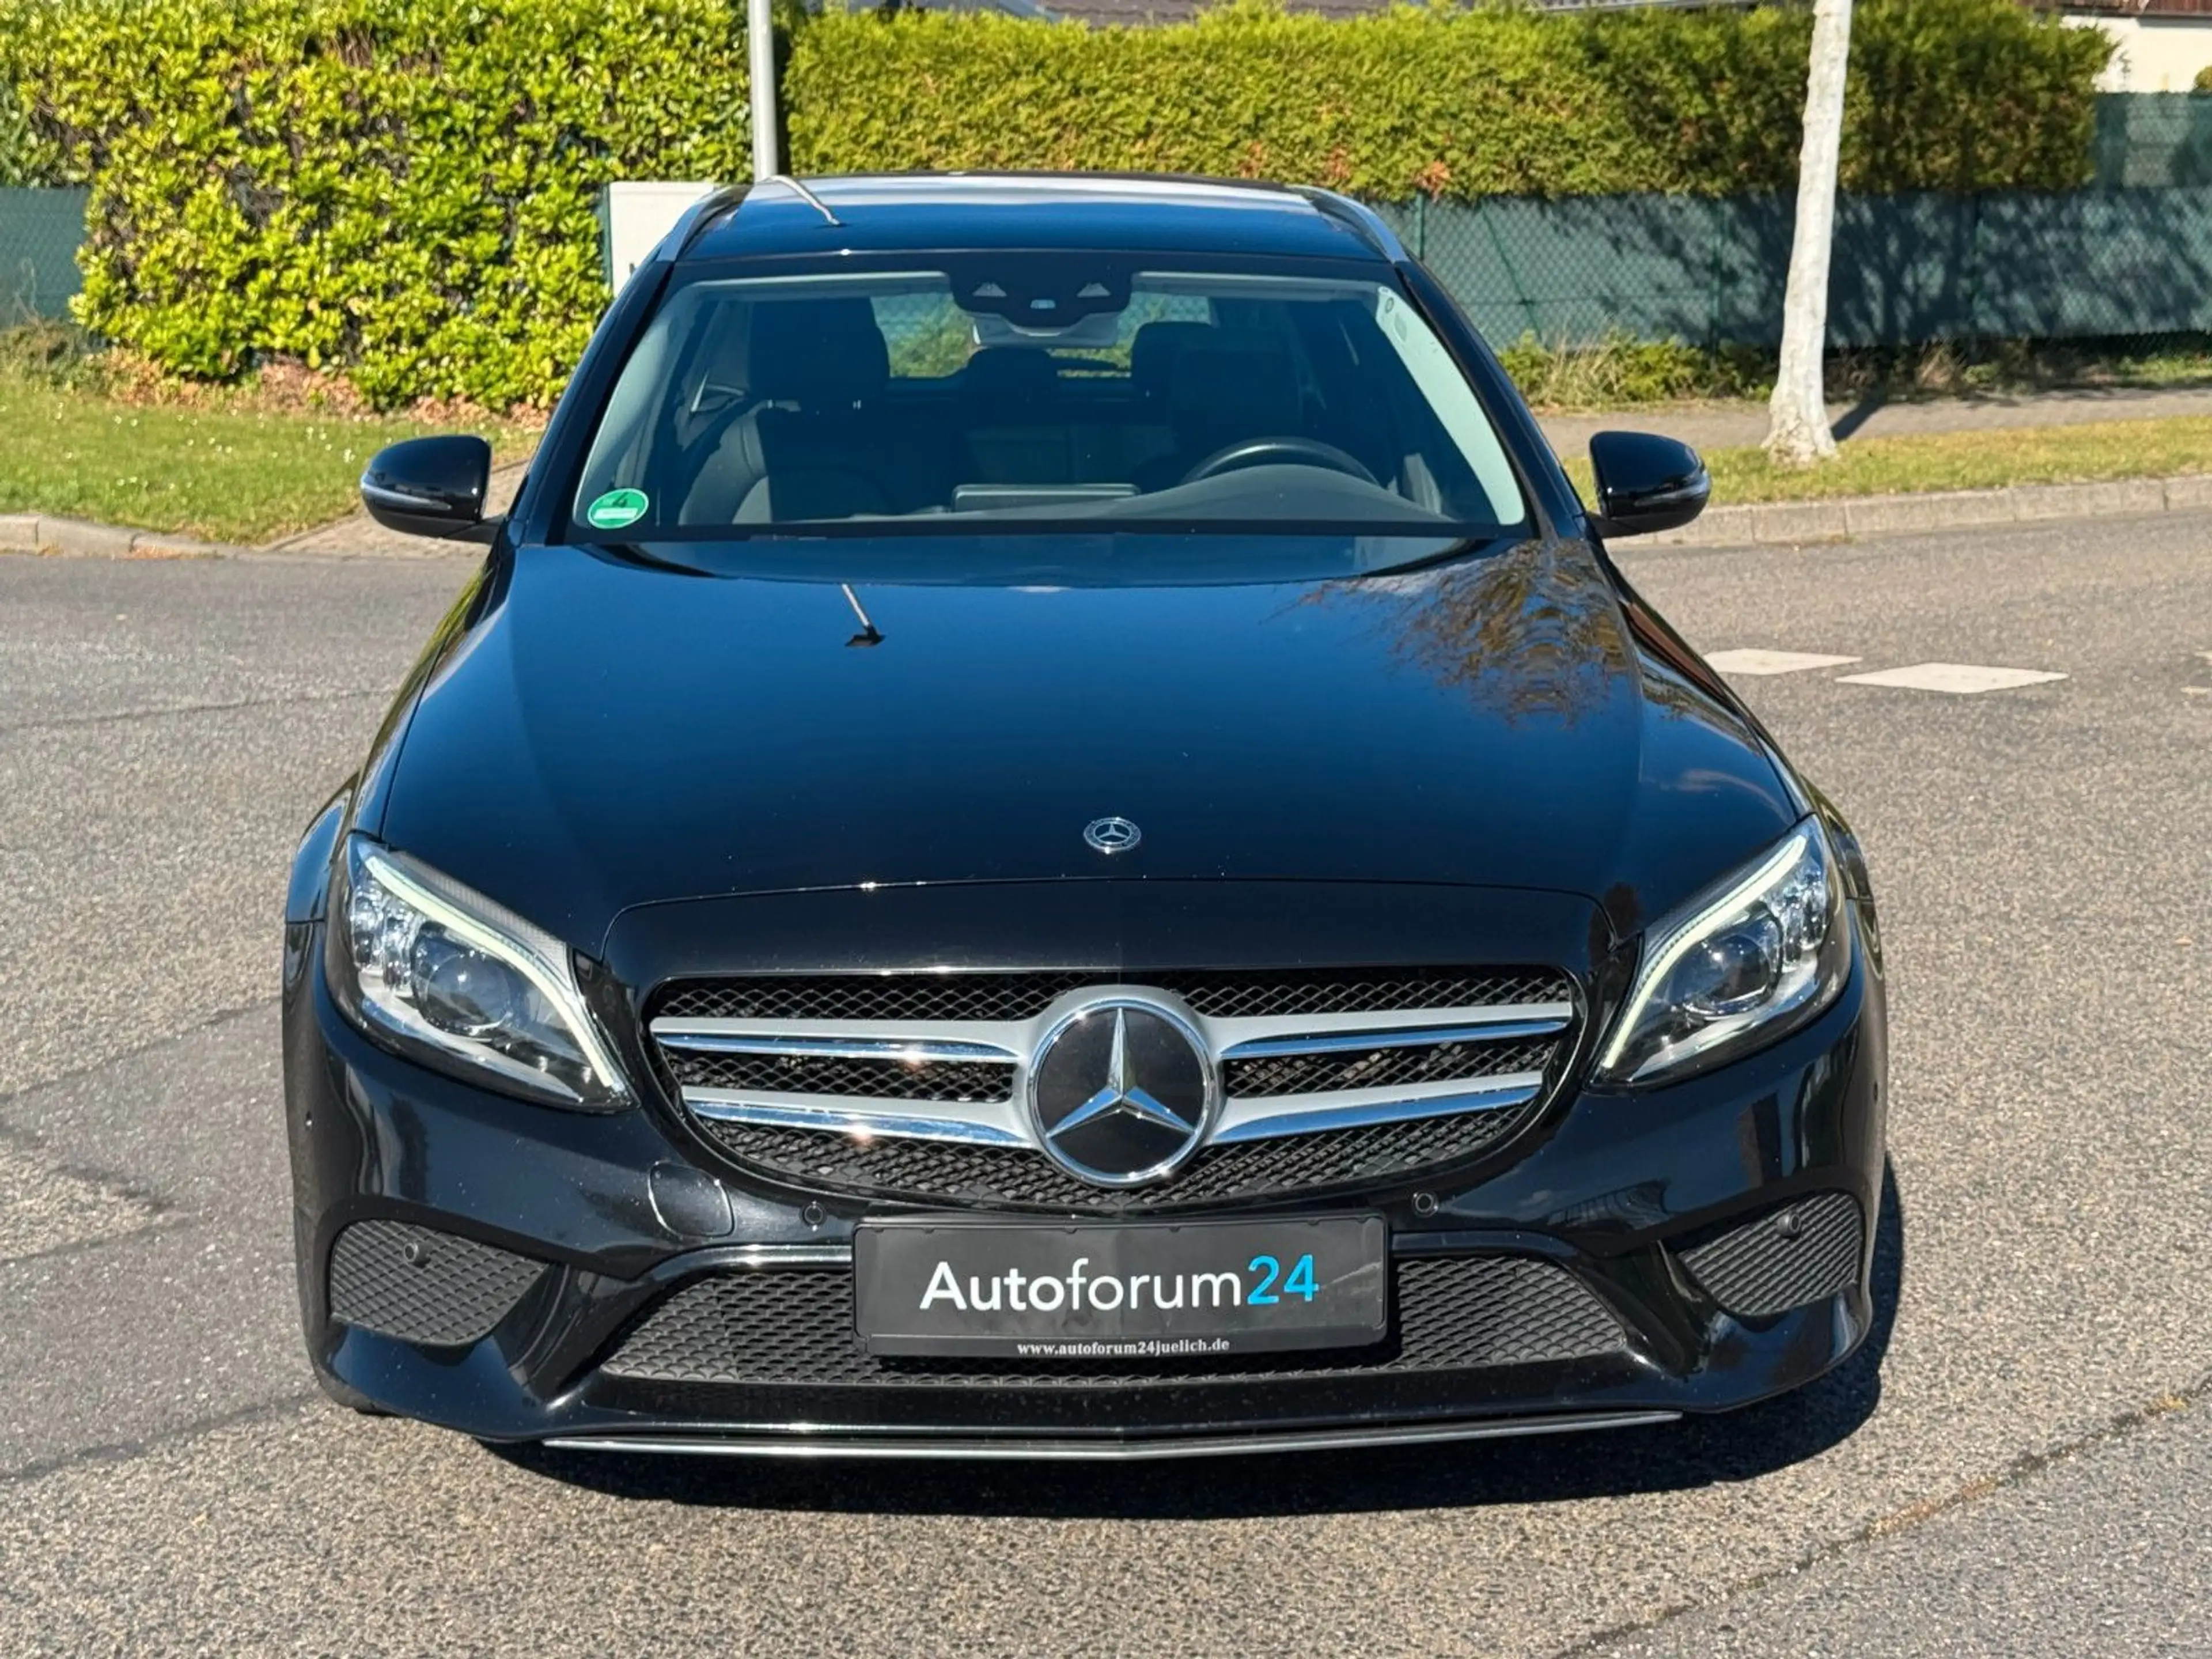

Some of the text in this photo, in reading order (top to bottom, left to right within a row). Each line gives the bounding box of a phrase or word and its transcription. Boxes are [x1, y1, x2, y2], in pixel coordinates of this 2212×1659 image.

[612, 492, 629, 507] 4
[919, 1254, 1319, 1312] Autoforum24
[1017, 1338, 1230, 1357] www.autoforum24juelich.de
